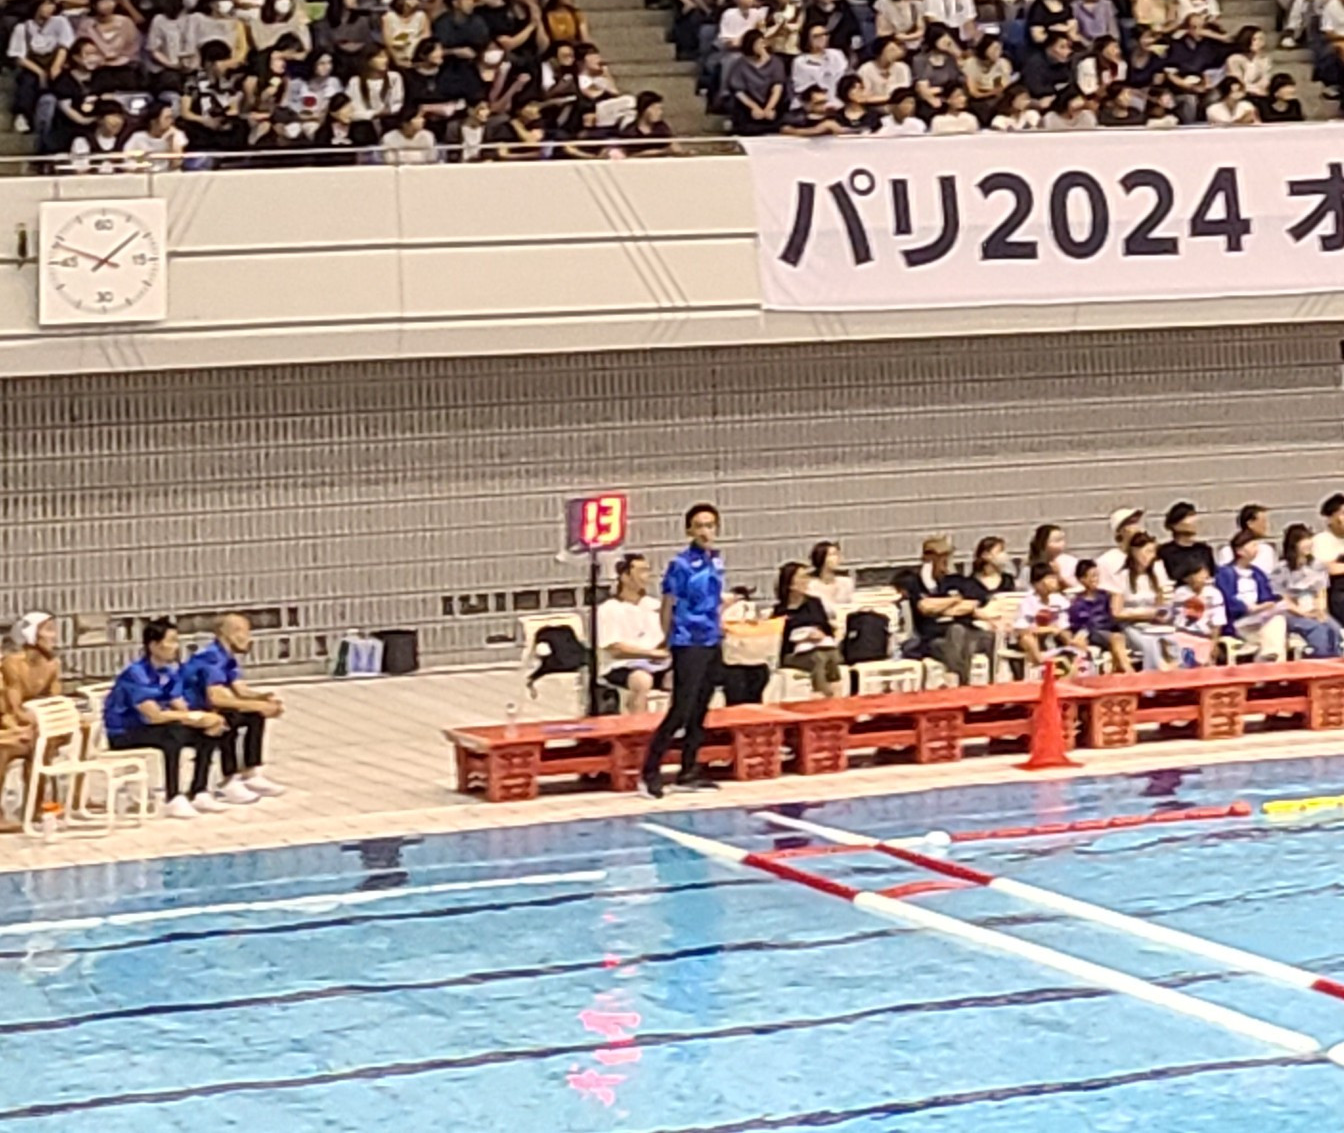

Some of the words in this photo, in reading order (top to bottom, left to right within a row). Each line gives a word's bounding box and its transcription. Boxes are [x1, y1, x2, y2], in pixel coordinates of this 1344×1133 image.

[94, 218, 114, 232] 60
[777, 166, 1252, 268] パリ2024
[584, 497, 622, 543] 13
